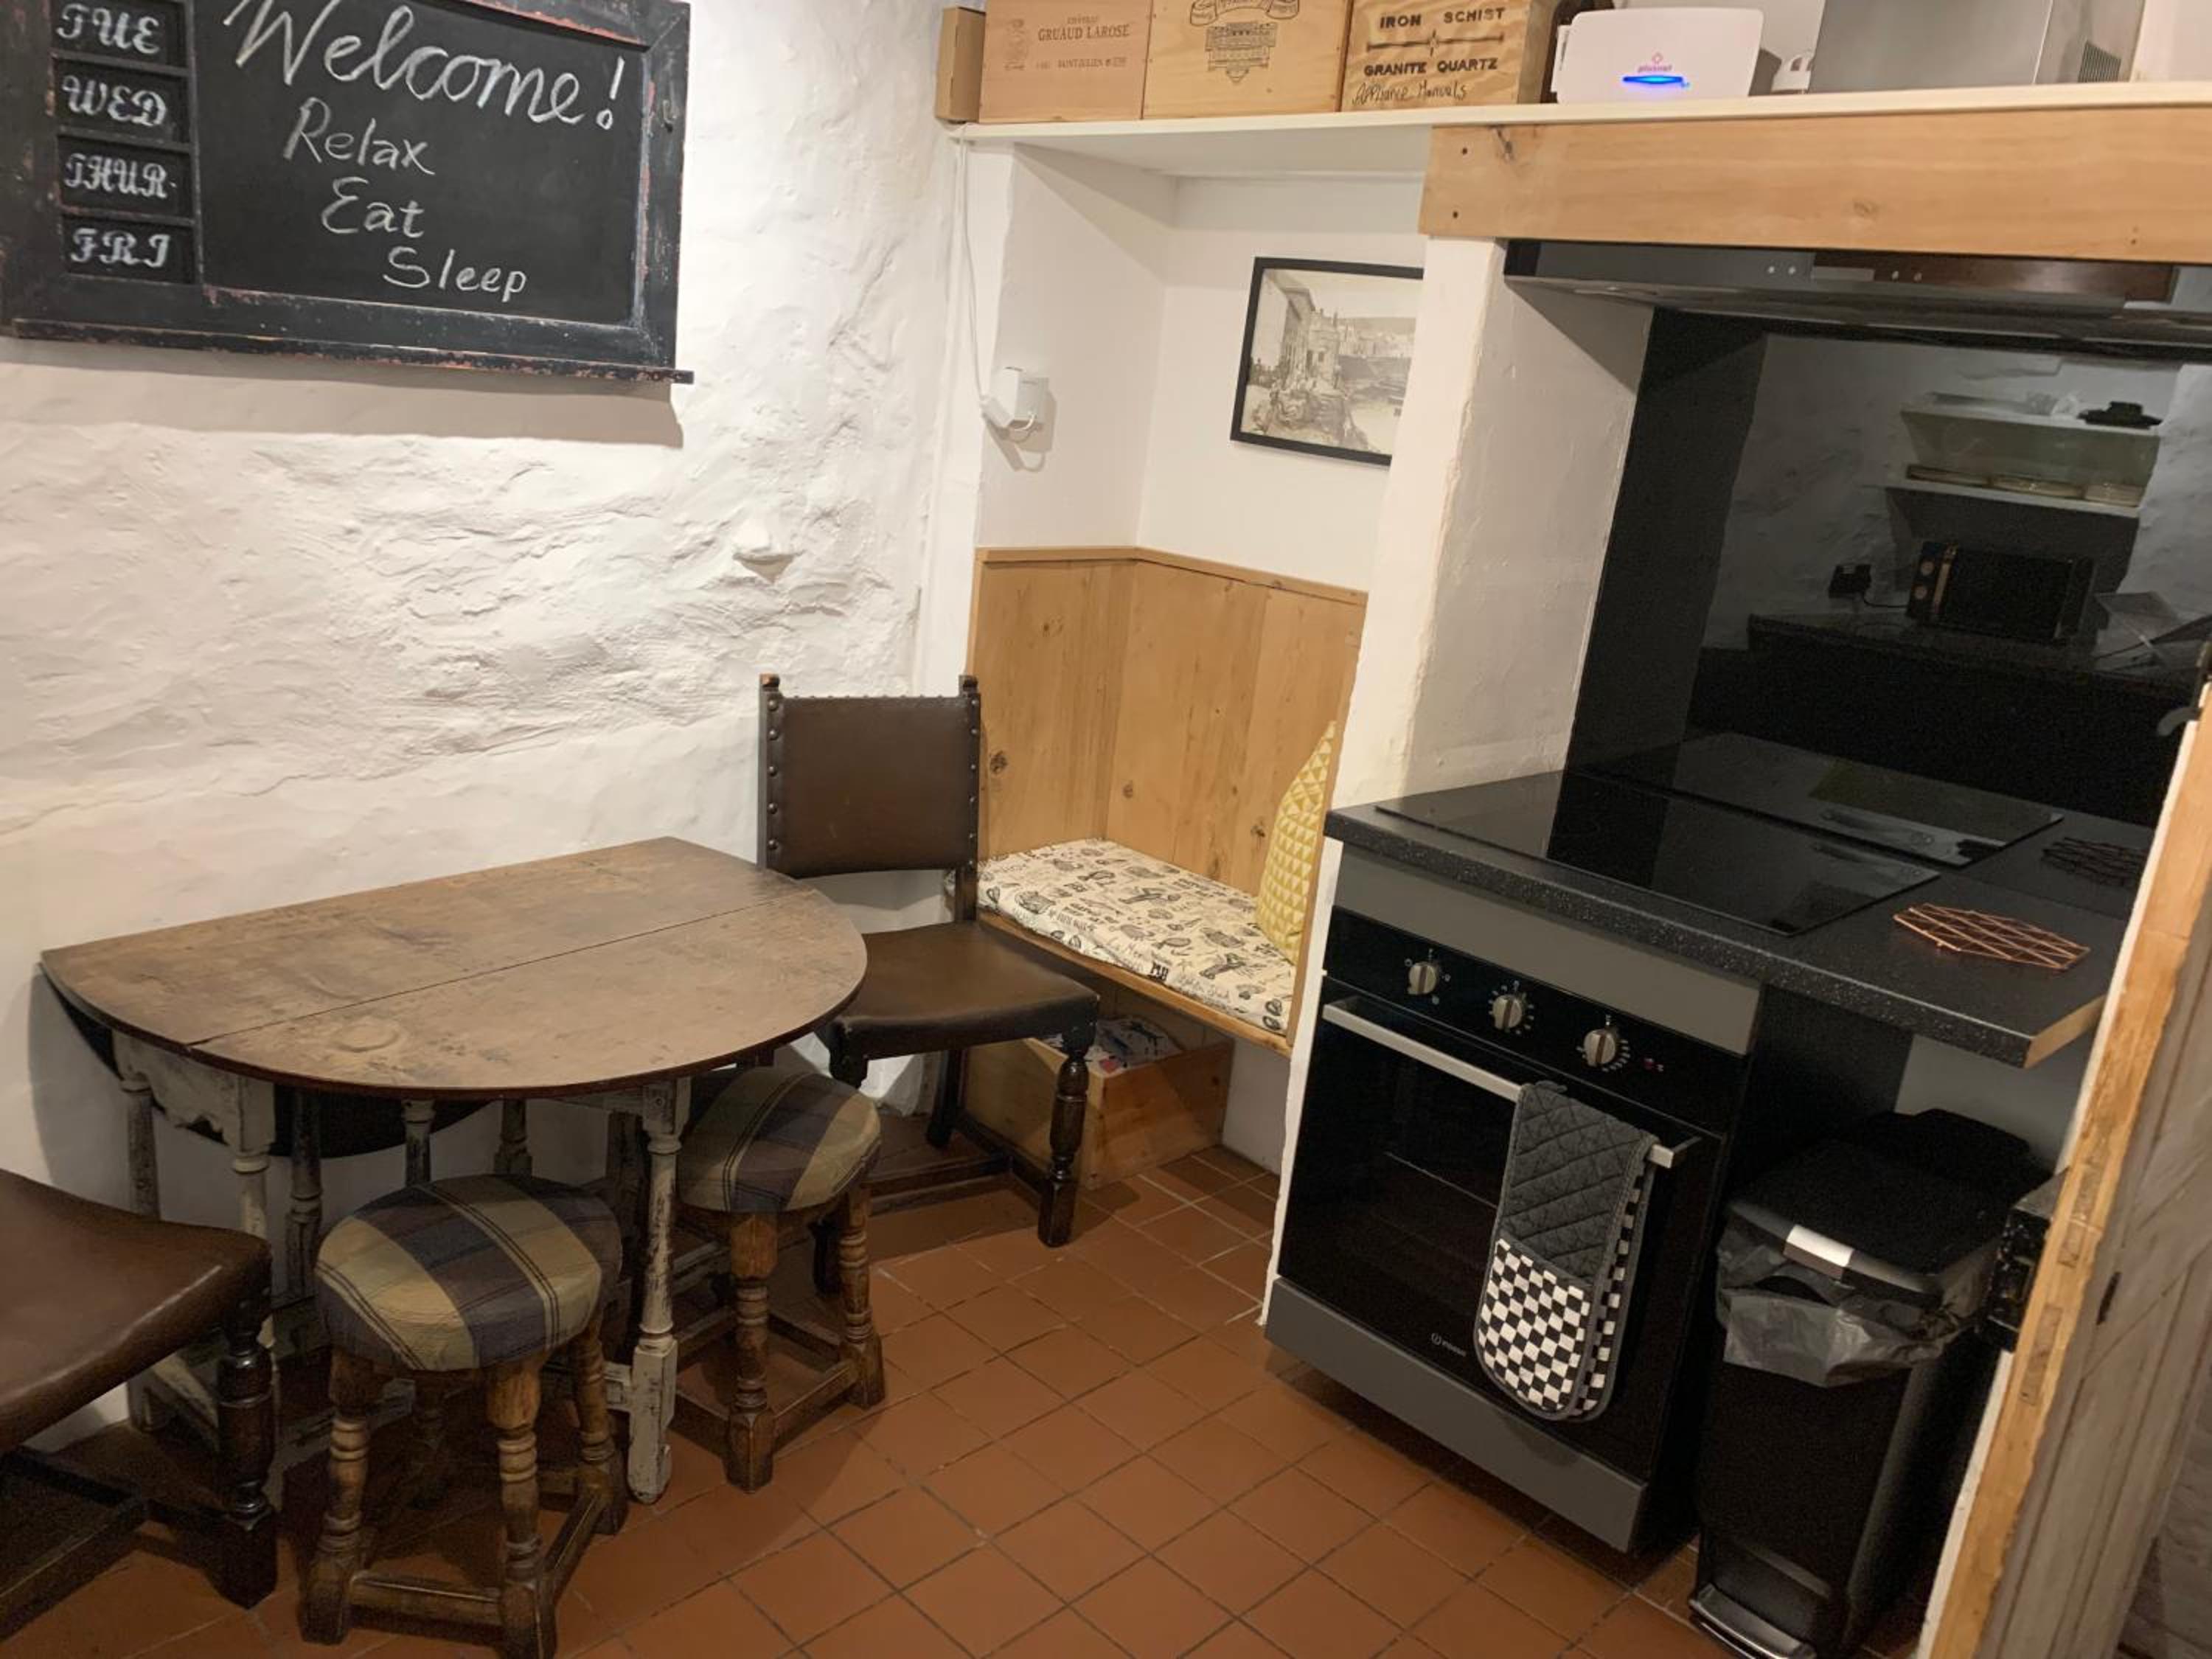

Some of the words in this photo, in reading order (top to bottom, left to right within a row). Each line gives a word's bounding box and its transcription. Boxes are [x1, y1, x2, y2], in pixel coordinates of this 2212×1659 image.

[56, 3, 159, 54] TUE
[1037, 26, 1083, 42] GRUAUD
[1380, 14, 1422, 29] IRON
[1443, 7, 1506, 24] SCHIST
[223, 0, 625, 130] Welcome!
[1364, 61, 1427, 77] GRANITE
[1437, 57, 1499, 72] QUARTZ
[63, 75, 166, 127] WED
[282, 97, 435, 175] Relax
[321, 176, 425, 237] Eat
[70, 227, 170, 268] FRI
[383, 246, 527, 302] Sleep
